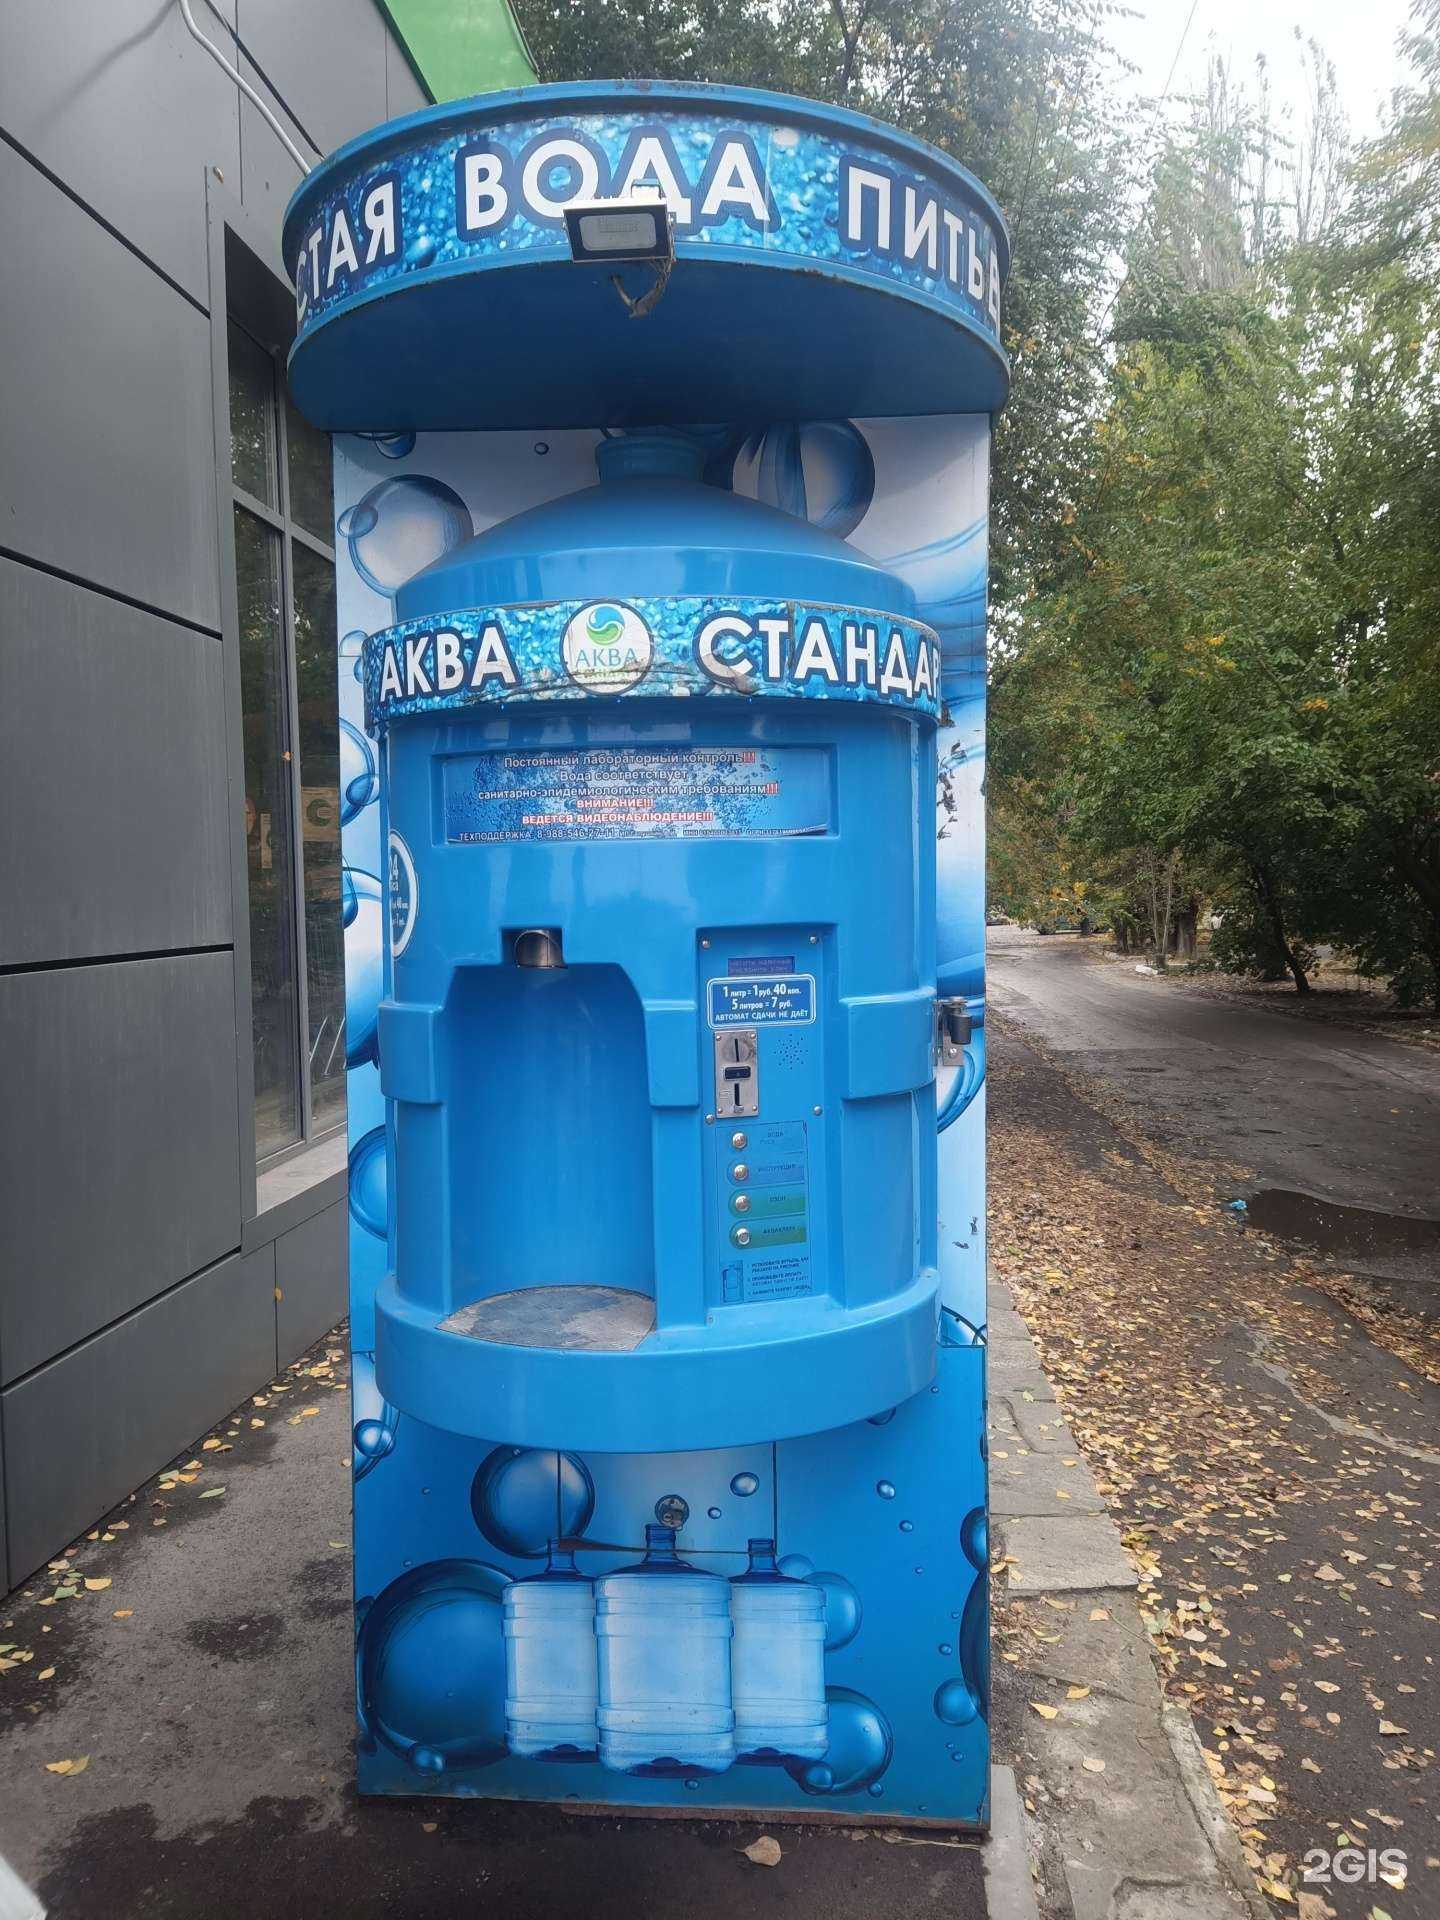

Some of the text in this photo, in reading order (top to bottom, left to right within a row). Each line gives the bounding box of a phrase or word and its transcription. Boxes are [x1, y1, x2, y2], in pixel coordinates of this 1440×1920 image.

[296, 181, 395, 322] СТАЯ
[465, 137, 770, 231] ВОДА
[380, 616, 939, 702] АКВА СТАНДАР
[576, 648, 638, 668] АКВА
[504, 751, 756, 768] Постоянный лабораторный контроль!!!
[560, 770, 688, 782] Вода соответствует
[478, 782, 779, 800] санитарно-эпидемиологическим требованиям!!!
[576, 797, 655, 808] ВНИМАНИЕ!!!
[522, 812, 713, 825] ВЕДЕТСЯ ВИДЕОНАБЛЮДЕНИЕ!!!
[723, 986, 729, 998] 1
[730, 990, 747, 998] литр
[773, 984, 787, 995] 40
[732, 998, 738, 1010] 5
[771, 997, 778, 1008] 7
[715, 1013, 749, 1021] АВТОМАТ
[751, 1011, 776, 1020] СДАЧИ
[778, 1010, 788, 1018] НЕ
